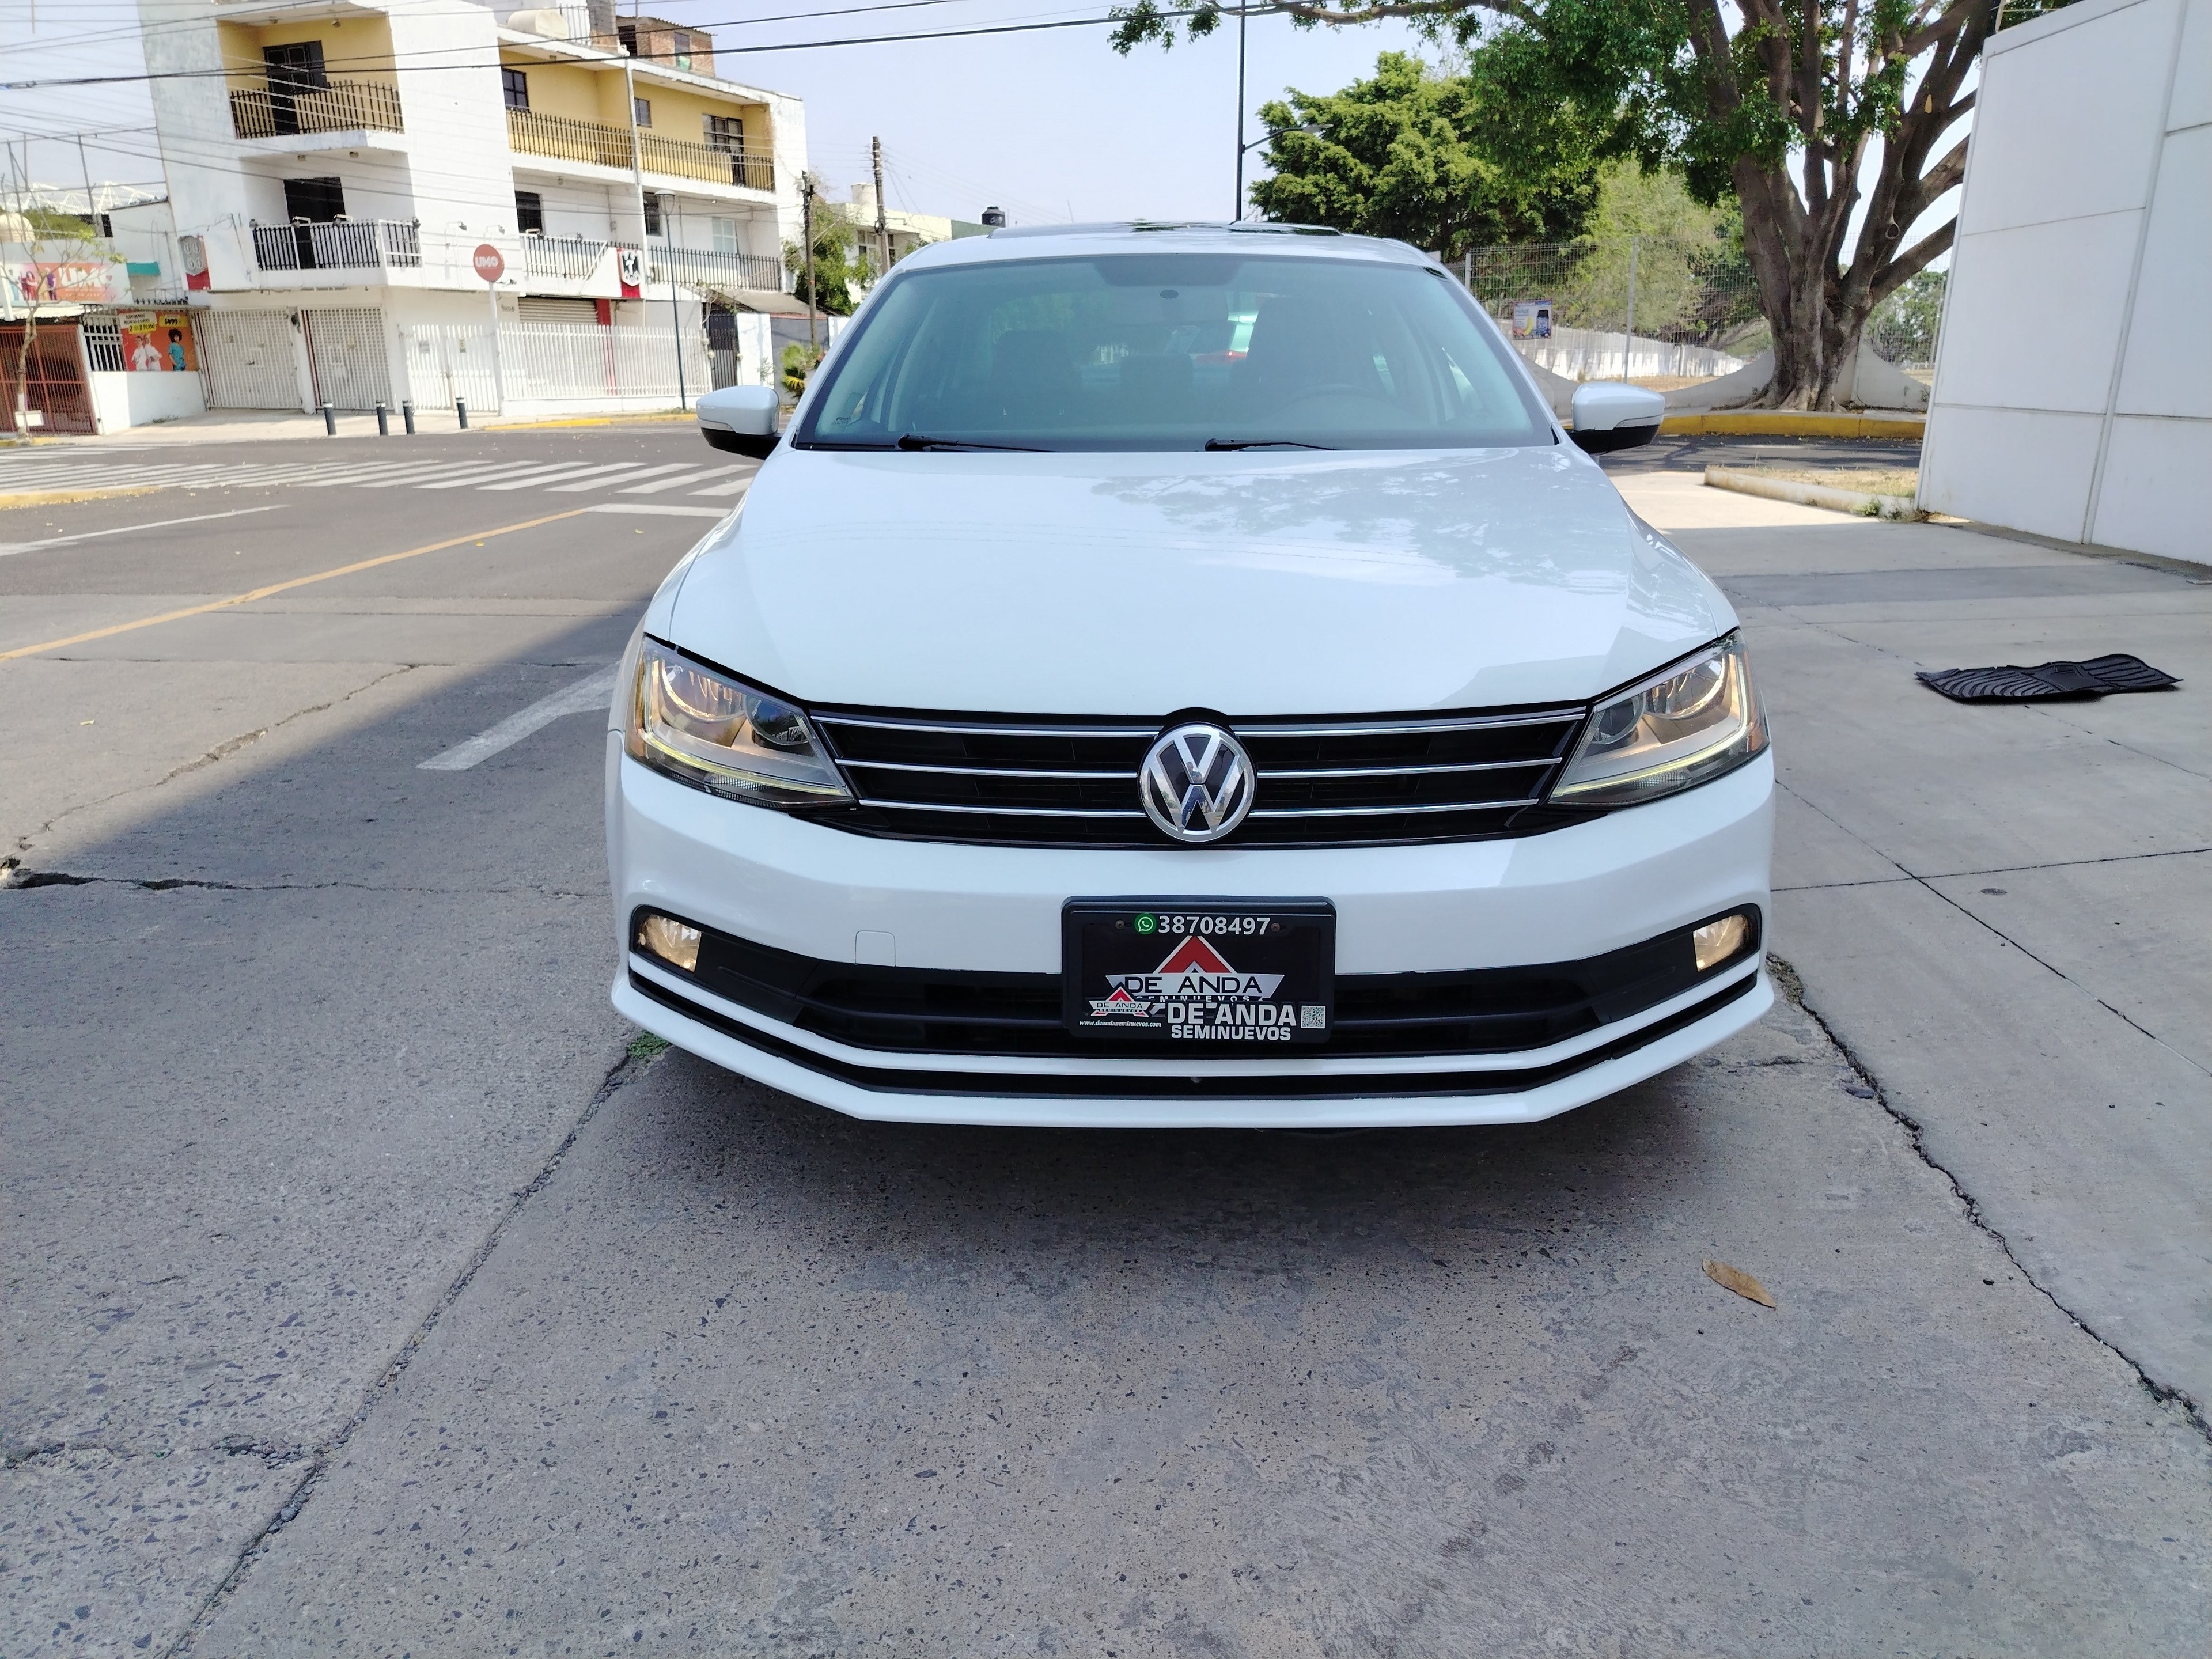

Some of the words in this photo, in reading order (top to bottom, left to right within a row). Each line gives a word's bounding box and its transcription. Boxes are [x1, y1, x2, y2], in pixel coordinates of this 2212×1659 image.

[475, 255, 499, 268] UMO
[1158, 915, 1270, 935] 38708497
[1124, 976, 1162, 993] DE
[1177, 976, 1263, 994] ANDA
[1167, 1002, 1204, 1024] DE
[1214, 1003, 1297, 1027] ANDA
[1079, 1020, 1161, 1028] www.deandaseminuevos.com
[1171, 1024, 1291, 1041] SEMINUEVOS
